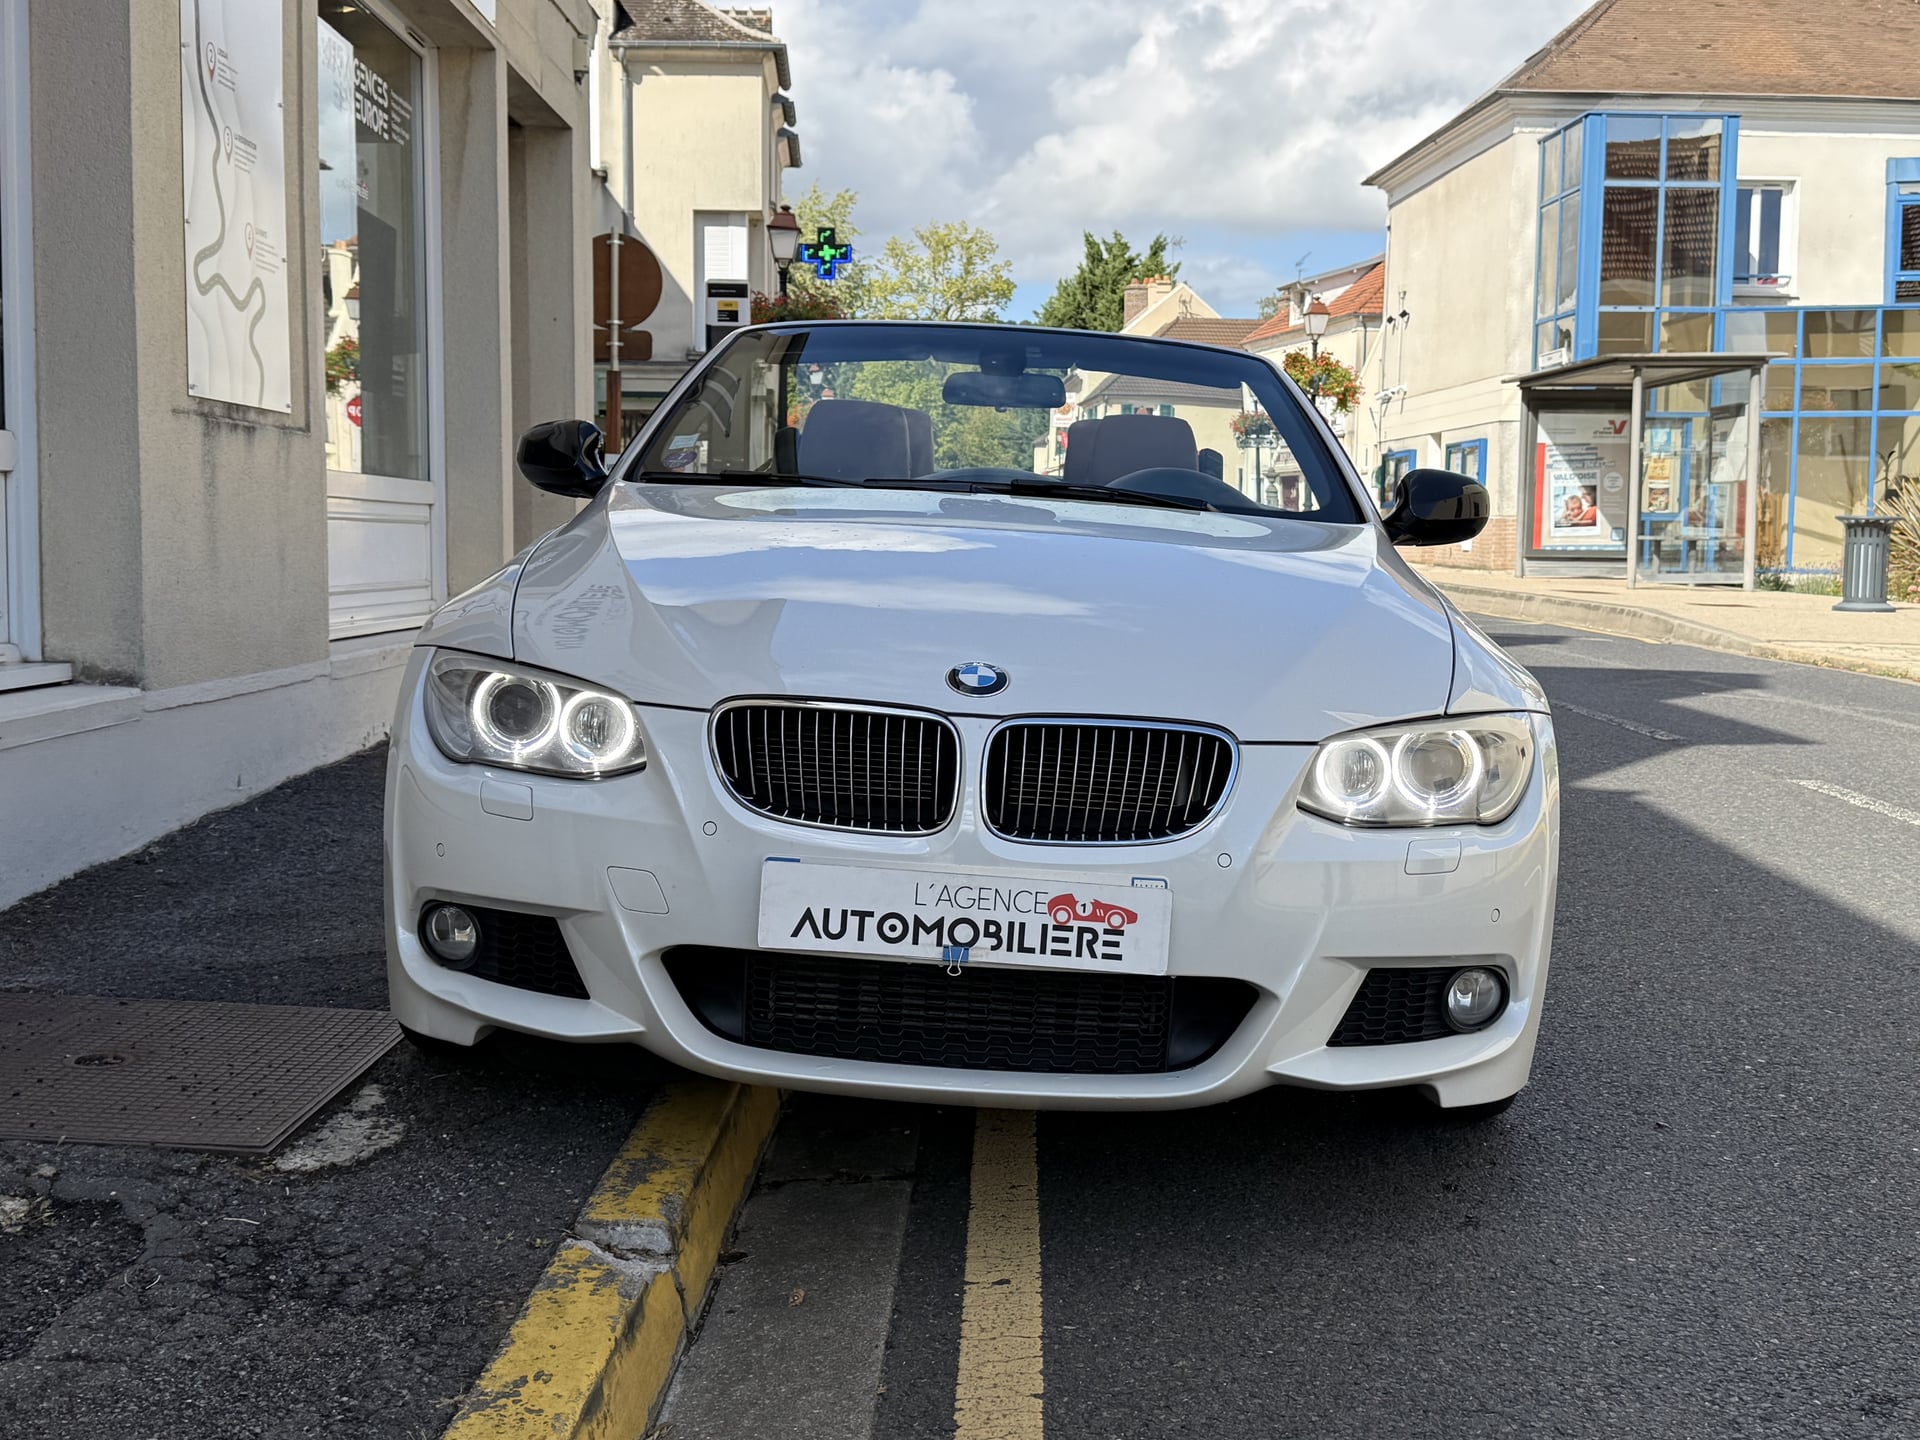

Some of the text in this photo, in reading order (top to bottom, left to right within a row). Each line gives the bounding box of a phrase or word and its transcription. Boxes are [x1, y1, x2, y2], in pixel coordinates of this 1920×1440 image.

[914, 882, 1049, 915] L'AGENCE
[1080, 903, 1087, 914] 1
[790, 906, 1125, 961] AUTOMOBILIERE
